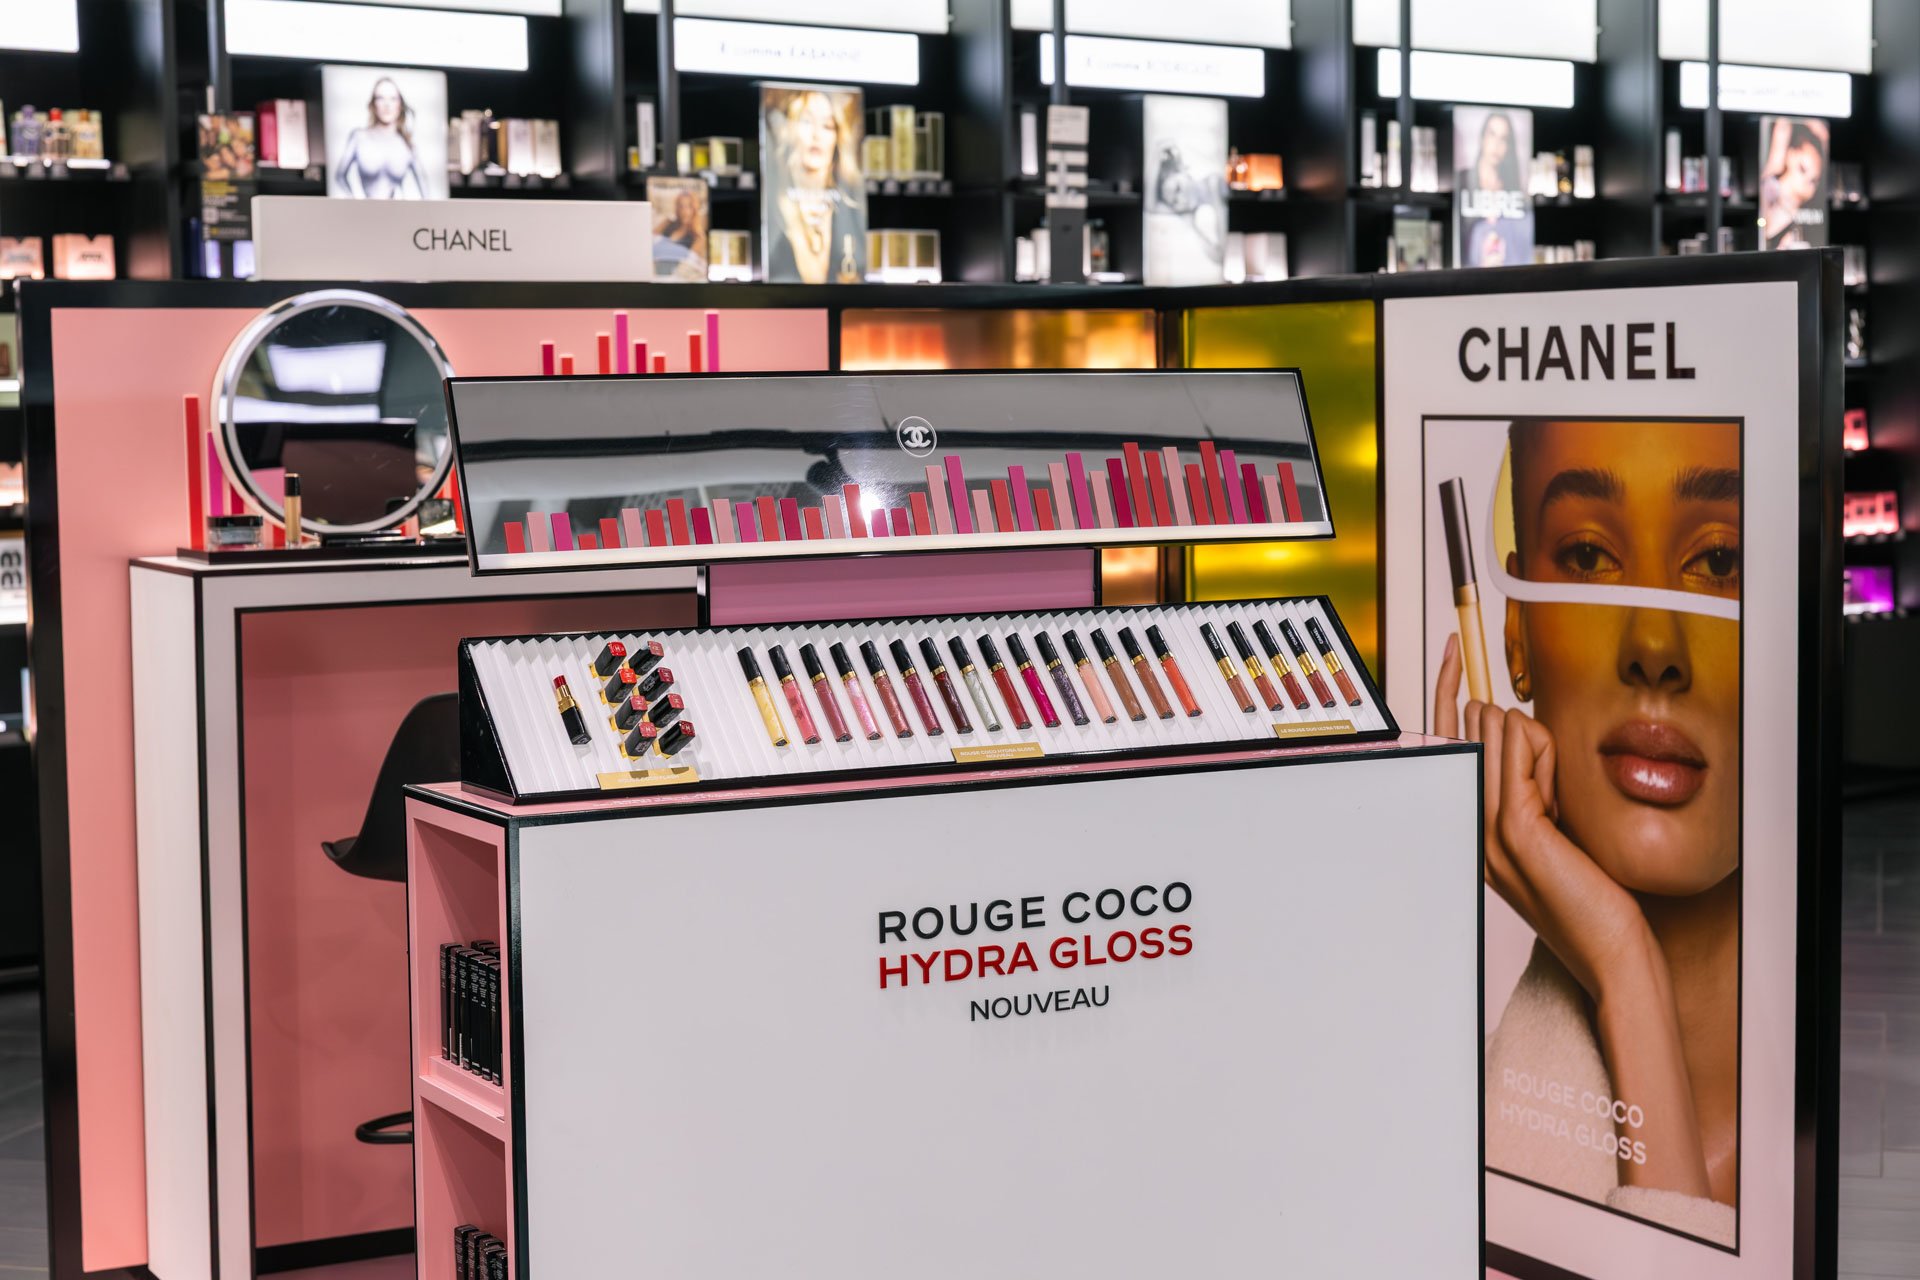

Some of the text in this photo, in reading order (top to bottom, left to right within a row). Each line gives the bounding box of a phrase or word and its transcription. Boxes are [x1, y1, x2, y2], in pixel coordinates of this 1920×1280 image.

[1461, 189, 1525, 219] LIBRE
[413, 227, 513, 252] CHANEL
[1458, 321, 1697, 383] CHANEL
[879, 881, 1193, 944] ROUGE COCO
[879, 924, 1194, 990] HYDRA GLOSS
[970, 985, 1110, 1022] NOUVEAU
[1503, 1069, 1645, 1129] ROUGE COCO
[1500, 1102, 1647, 1166] HYDRA GLOSS
